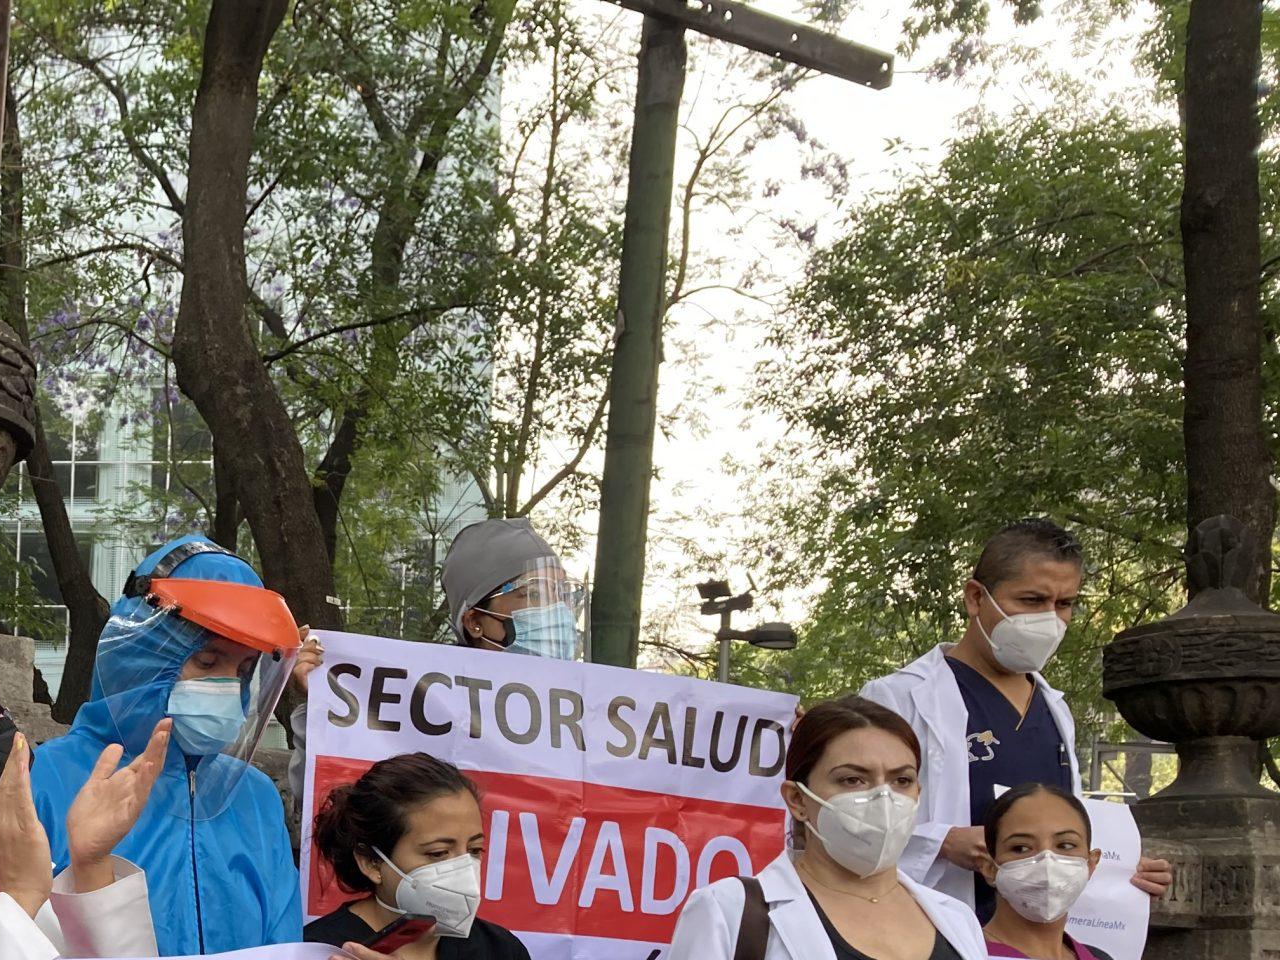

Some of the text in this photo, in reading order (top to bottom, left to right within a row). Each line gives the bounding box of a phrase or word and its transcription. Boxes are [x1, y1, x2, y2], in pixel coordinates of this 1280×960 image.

[326, 663, 786, 778] SECTOR SALUD
[485, 810, 753, 915] IVADO
